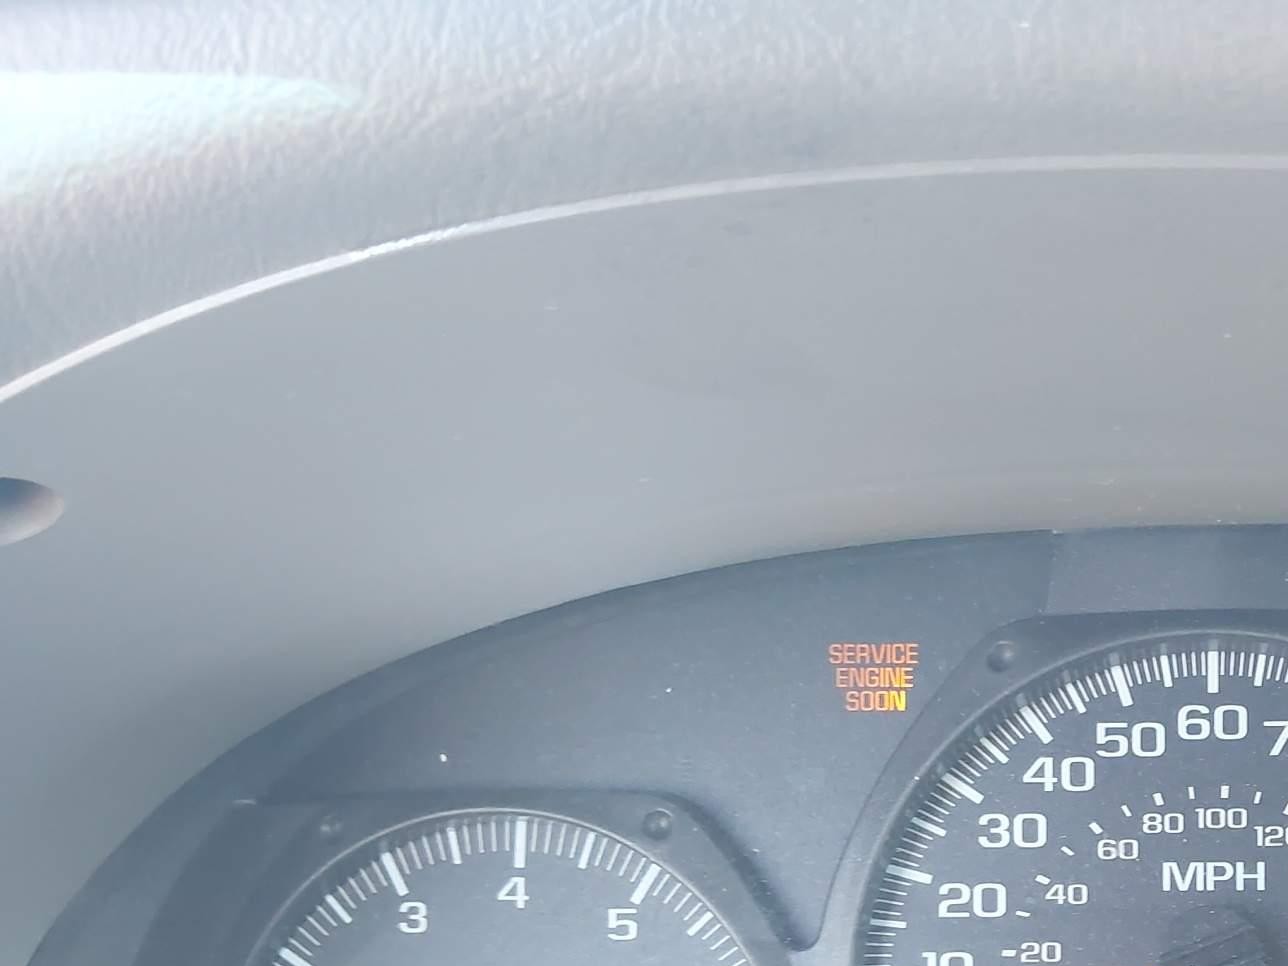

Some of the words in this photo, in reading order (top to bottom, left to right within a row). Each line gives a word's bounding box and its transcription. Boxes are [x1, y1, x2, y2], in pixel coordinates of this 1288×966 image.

[828, 643, 919, 664] SERVICE
[836, 667, 914, 688] ENGINE
[846, 690, 906, 711] SOON
[1177, 706, 1249, 740] 60
[1096, 722, 1166, 757] 50
[1023, 757, 1095, 793] 40
[978, 814, 1047, 849] 30
[1142, 812, 1185, 836] 80
[1196, 808, 1249, 831] 100
[1097, 838, 1139, 861] 60
[1162, 863, 1267, 892] MPH
[497, 876, 530, 909] 4
[938, 884, 1007, 918] 20
[1045, 884, 1088, 906] 40
[399, 902, 429, 934] 3
[607, 908, 640, 941] 5
[1020, 942, 1062, 964] 20
